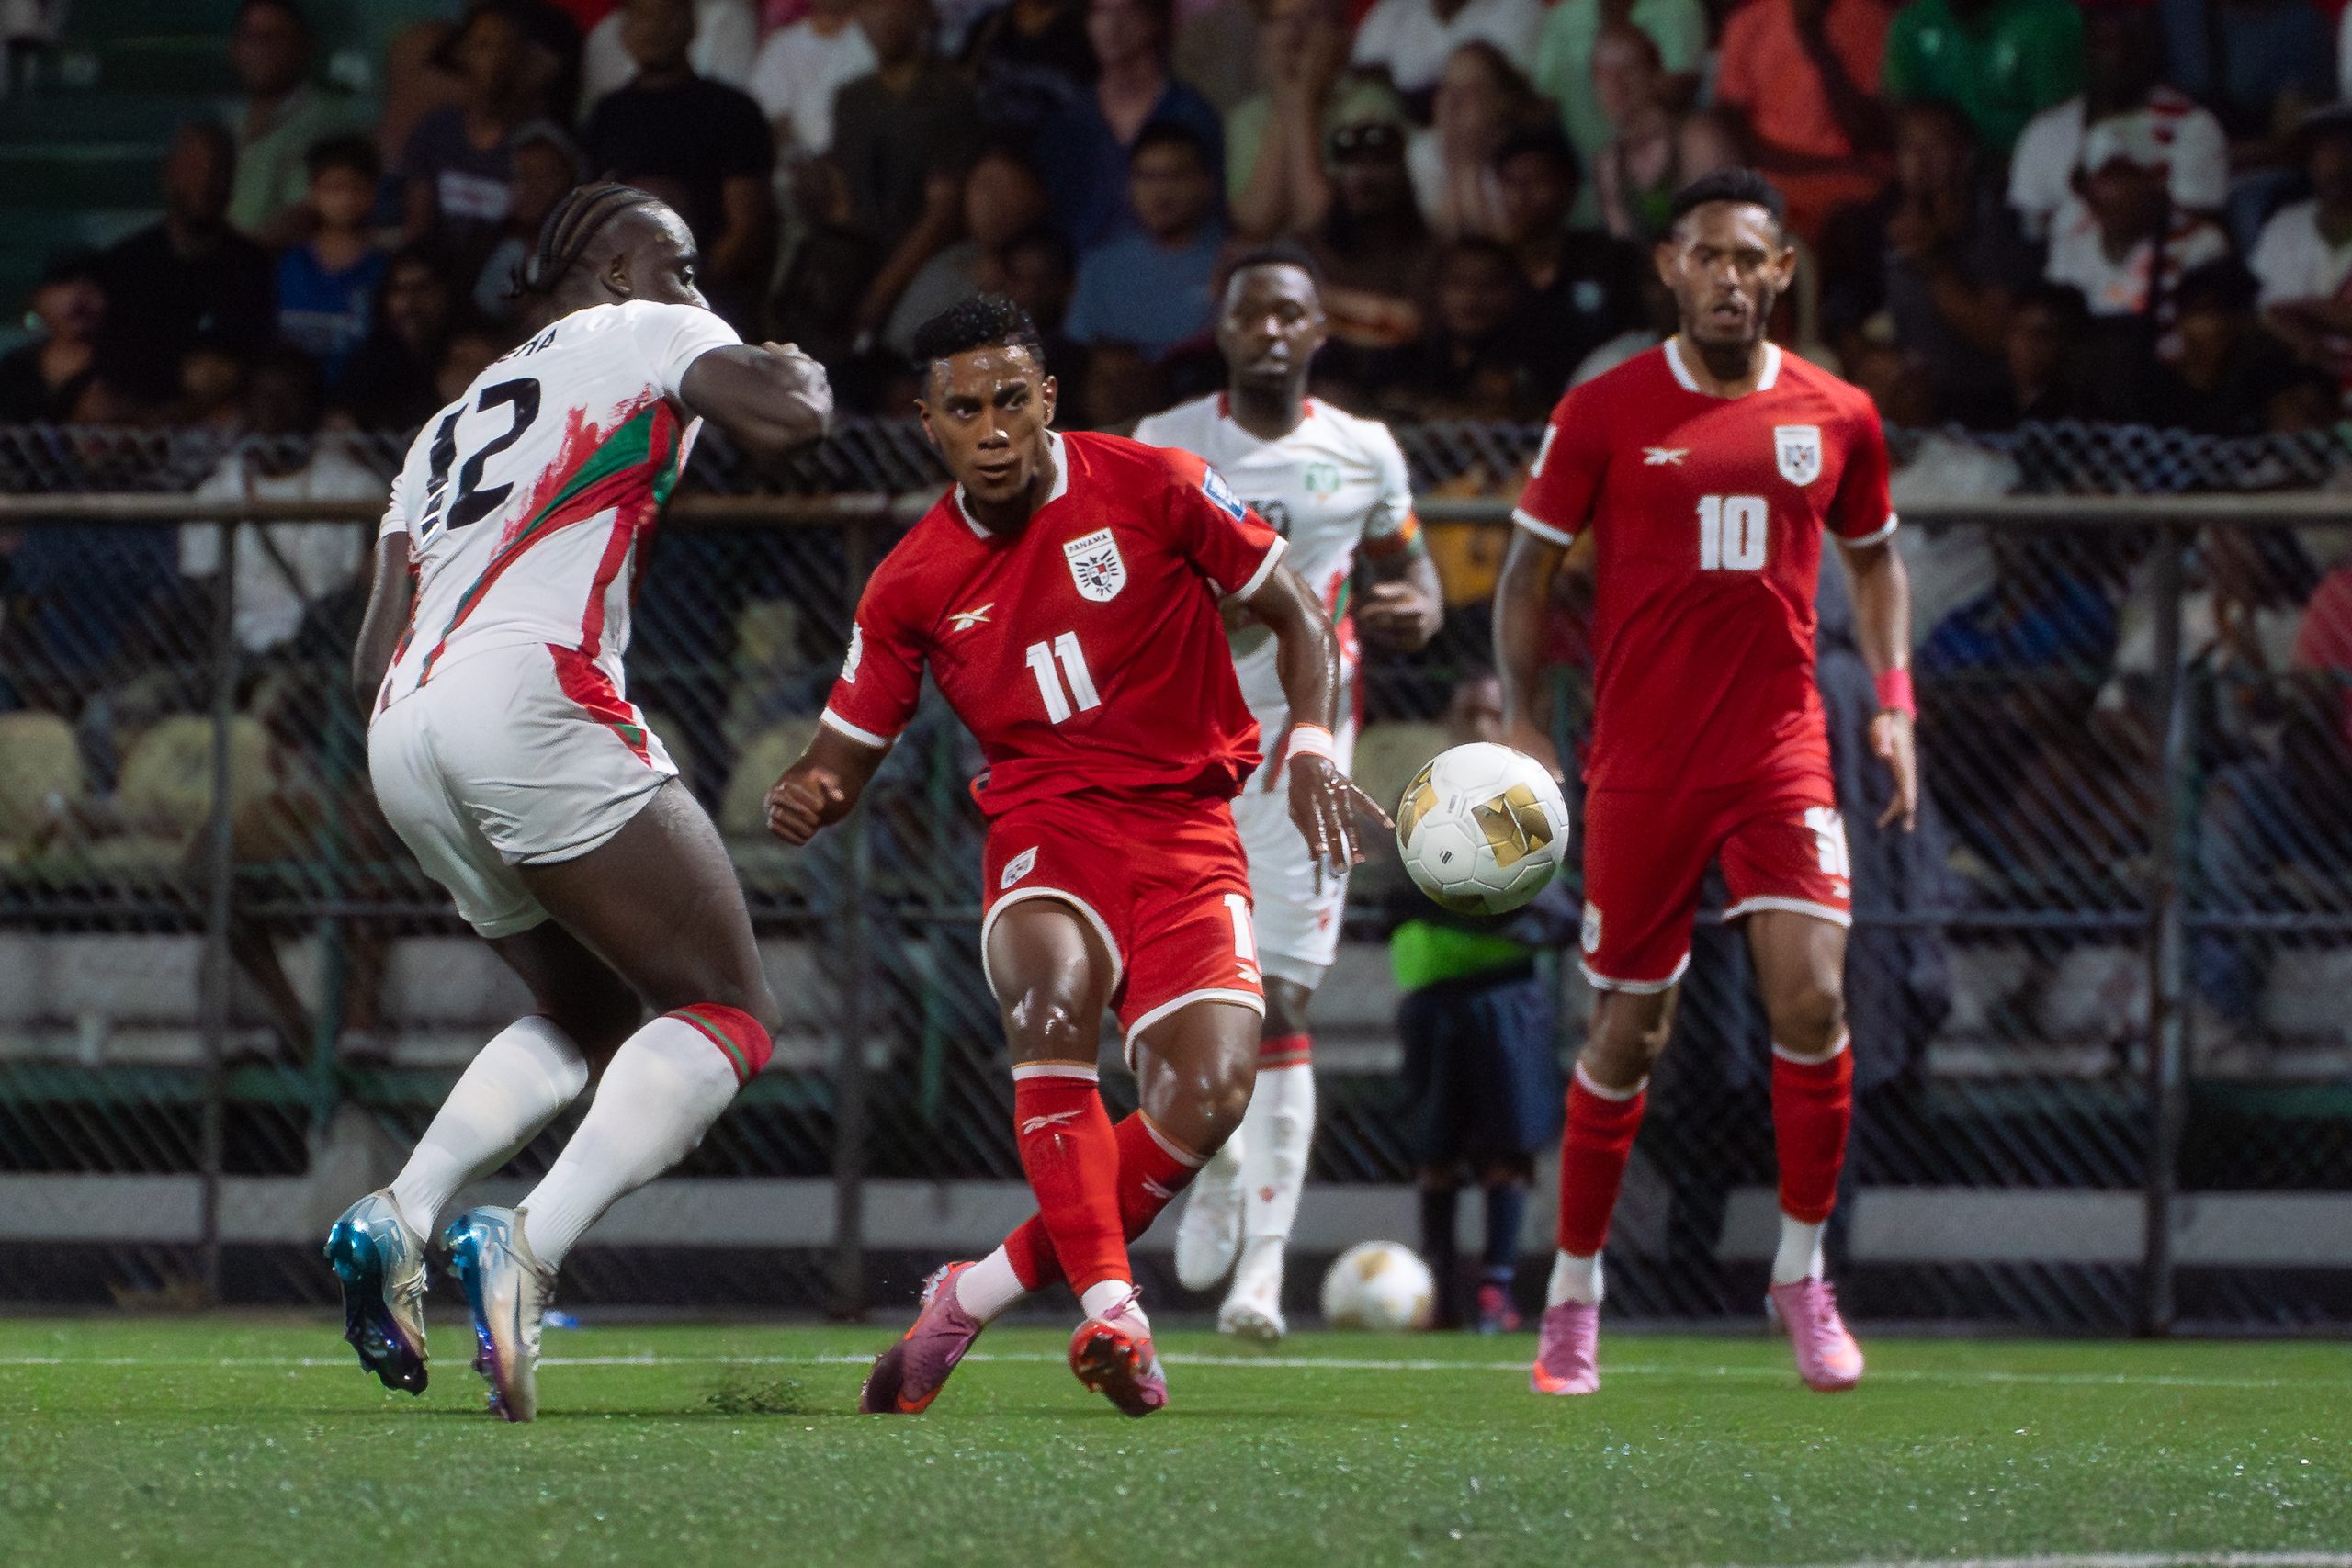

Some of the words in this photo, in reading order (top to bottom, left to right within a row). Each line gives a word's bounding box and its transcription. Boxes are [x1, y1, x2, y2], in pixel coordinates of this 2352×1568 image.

[420, 378, 541, 531] 12
[1068, 533, 1109, 553] PANAMA
[1697, 495, 1768, 570] 10
[1025, 631, 1102, 725] 11
